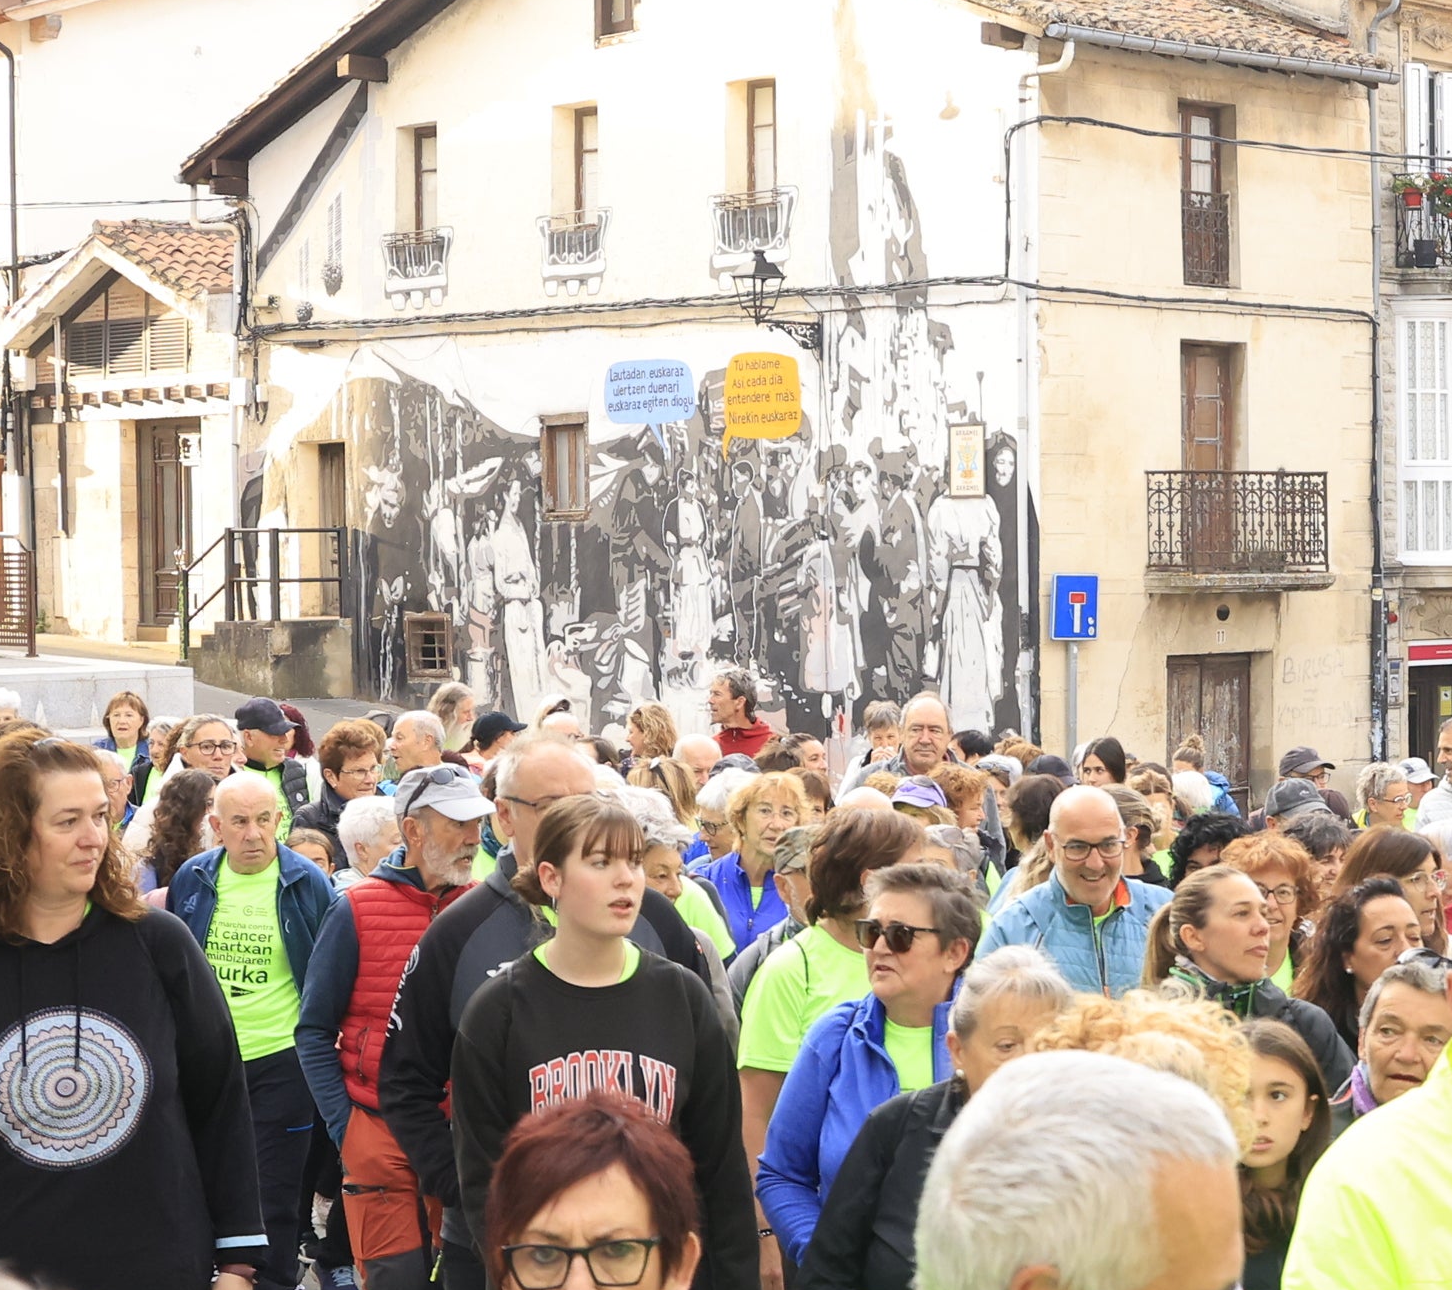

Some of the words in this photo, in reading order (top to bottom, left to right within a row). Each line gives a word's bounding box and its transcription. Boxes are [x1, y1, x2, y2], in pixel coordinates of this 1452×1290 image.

[647, 380, 680, 394] duenari
[746, 375, 766, 387] cada
[607, 399, 641, 413] euskaraz
[642, 395, 669, 413] egiten
[670, 394, 694, 413] diogu
[760, 409, 798, 423] euskaraz
[1216, 630, 1226, 644] 11
[219, 921, 246, 929] marcha
[248, 922, 274, 931] contra
[222, 928, 274, 943] cáncer
[205, 940, 272, 955] martxan
[207, 951, 272, 965] minbiziaren
